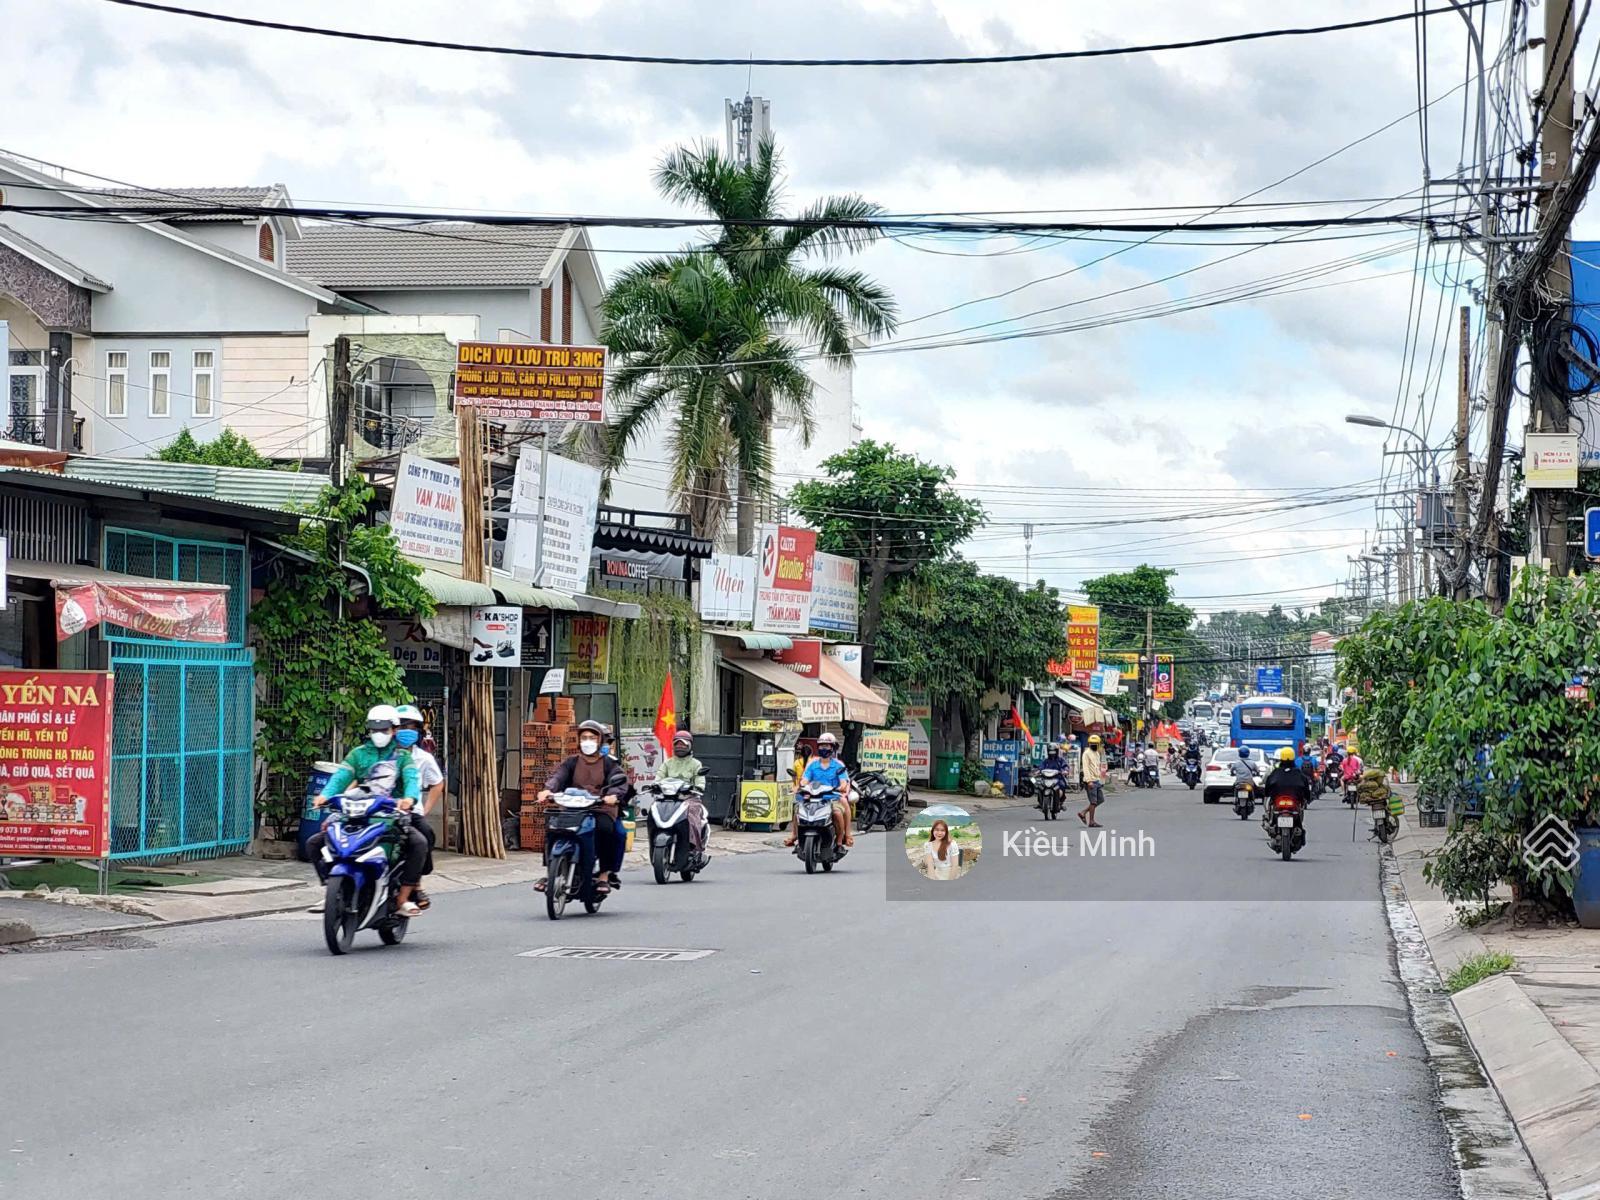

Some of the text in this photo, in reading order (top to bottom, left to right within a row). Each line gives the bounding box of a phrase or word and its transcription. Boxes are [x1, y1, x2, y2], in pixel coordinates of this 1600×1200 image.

[573, 351, 603, 368] 3MC
[424, 647, 440, 662] Da
[1, 676, 100, 706] YẾN NA
[18, 709, 39, 724] PHỐI
[55, 713, 62, 724] &
[35, 727, 53, 741] YẾN
[878, 739, 907, 752] KHANG
[55, 749, 67, 762] HẠ
[70, 747, 94, 761] THẢO
[13, 763, 29, 778] GIỎ
